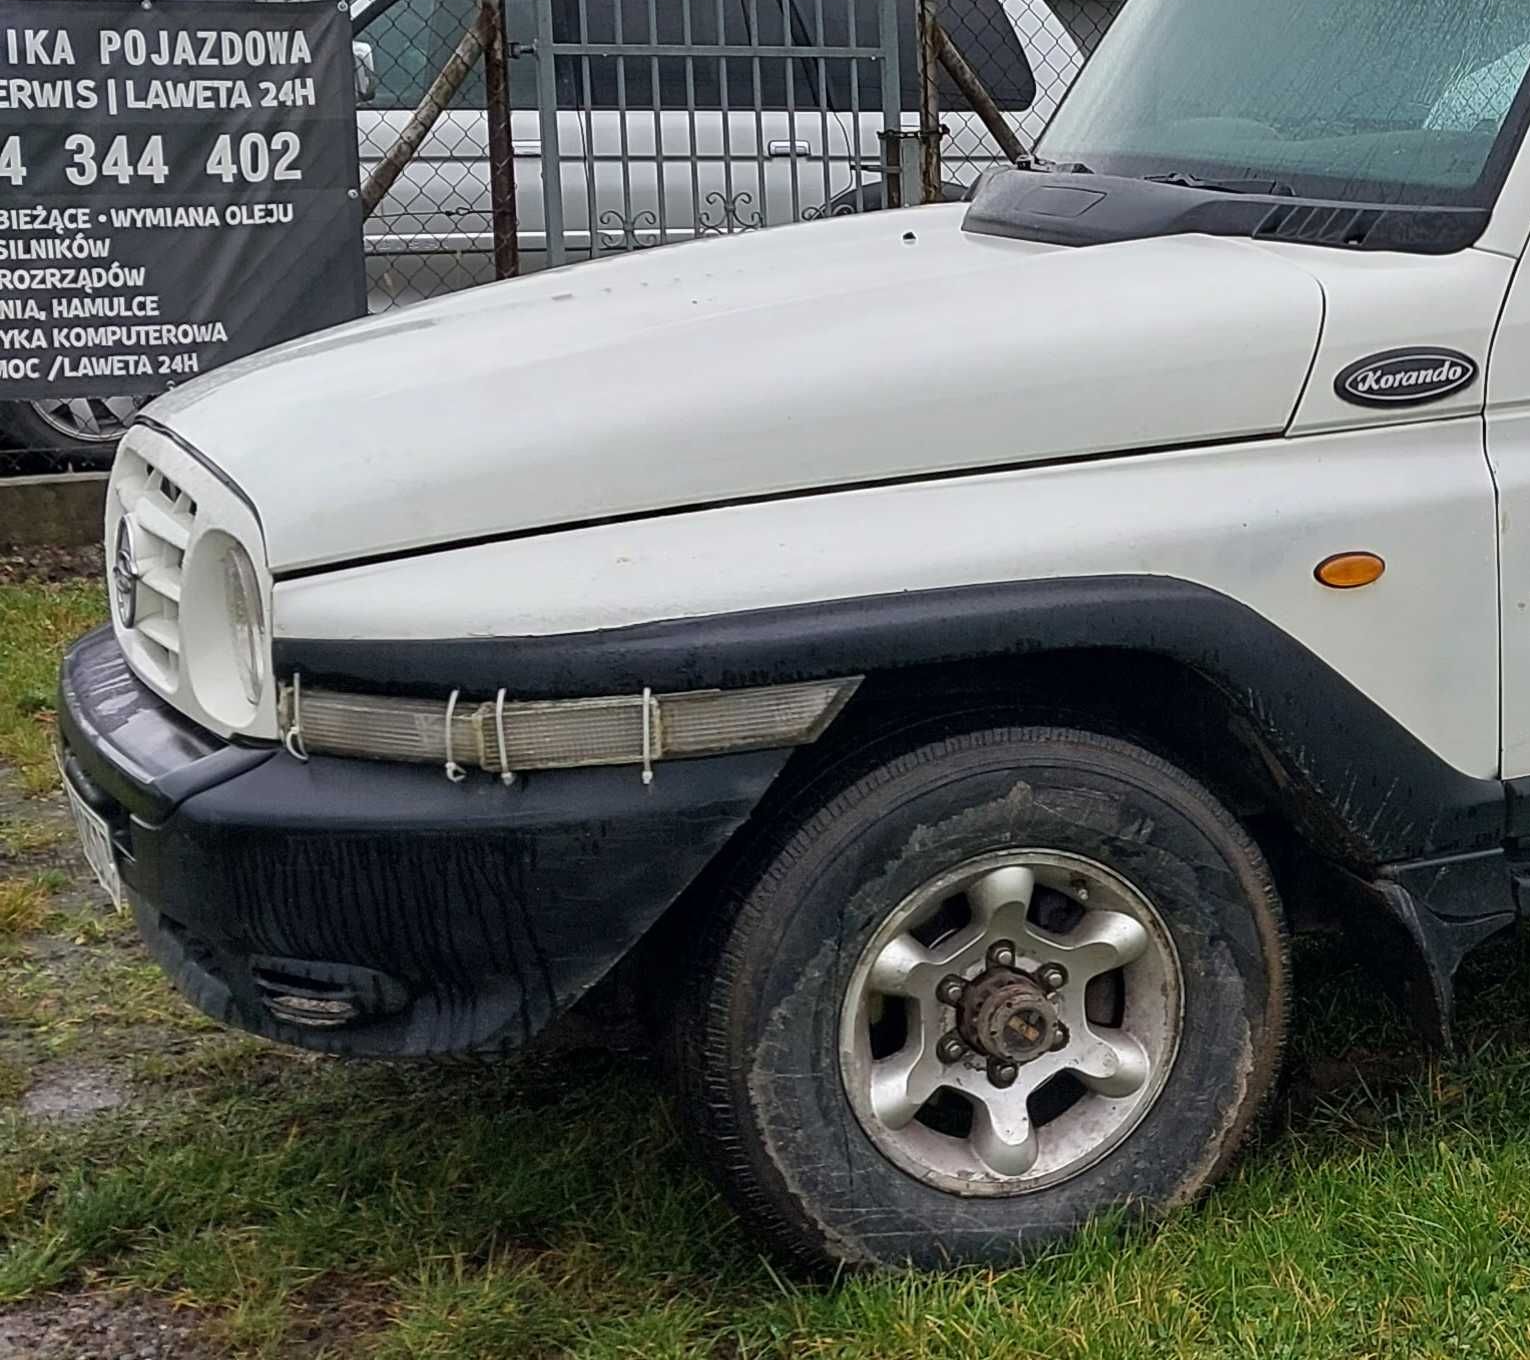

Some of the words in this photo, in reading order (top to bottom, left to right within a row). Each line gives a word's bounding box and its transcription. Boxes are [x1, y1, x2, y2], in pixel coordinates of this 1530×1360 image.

[7, 28, 76, 65] IKA
[99, 29, 312, 66] POJAZDOWA
[126, 79, 252, 110] LAWETA
[259, 77, 316, 107] 24H
[64, 134, 169, 186] 344
[206, 131, 303, 183] 402
[110, 205, 220, 229] WYMIANA
[225, 203, 294, 226] OLEJU
[52, 296, 160, 319] HAMULCE
[52, 322, 228, 348] KOMPUTEROWA
[158, 353, 199, 375] 24H
[1356, 360, 1463, 392] Korando
